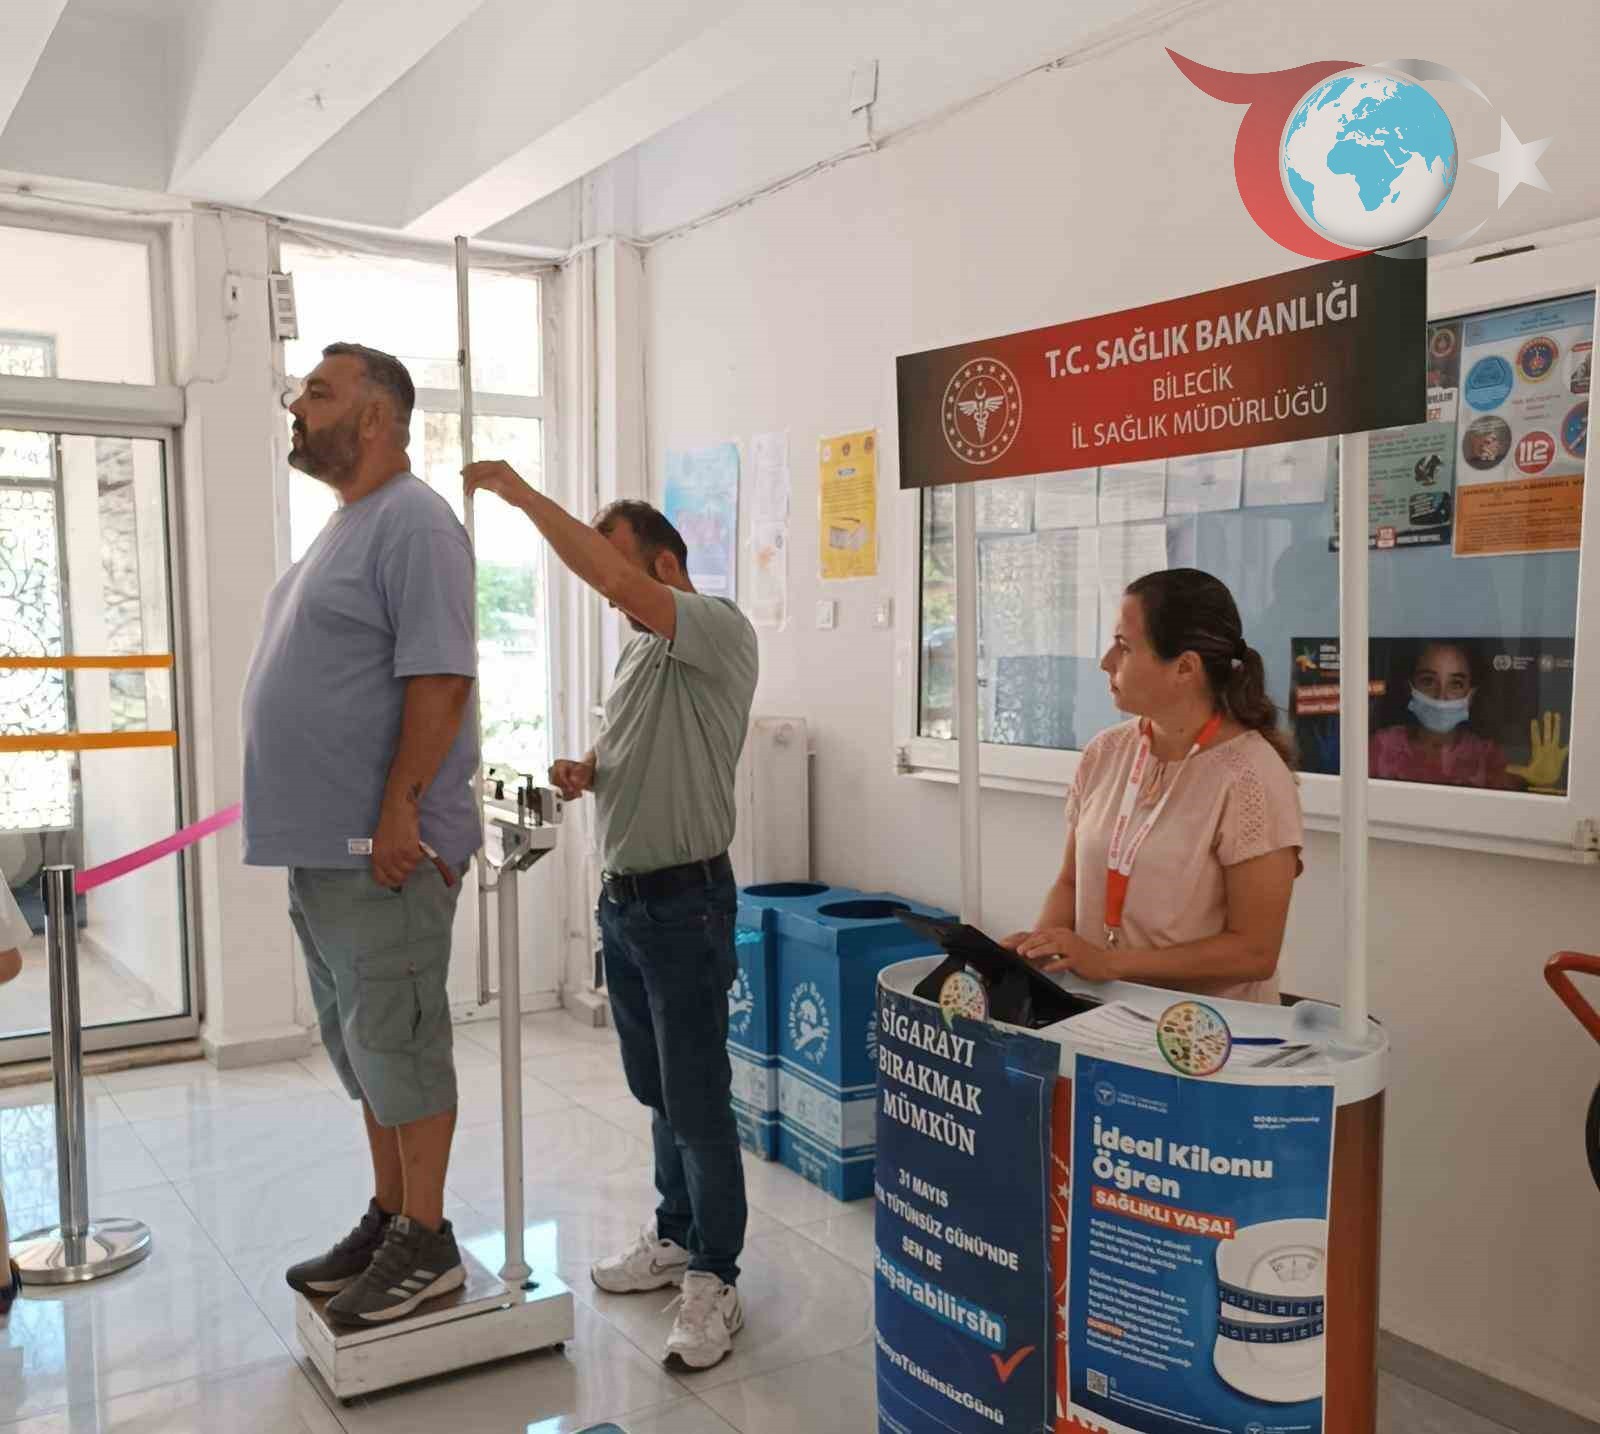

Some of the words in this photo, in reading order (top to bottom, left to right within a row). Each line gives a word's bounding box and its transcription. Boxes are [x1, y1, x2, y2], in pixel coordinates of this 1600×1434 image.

[1046, 345, 1090, 378] T.C.
[1096, 324, 1189, 371] SAĞLIK
[1195, 280, 1358, 352] BAKANLIĞI
[1152, 365, 1233, 402] BİLECİK
[1072, 422, 1089, 449] İL
[1094, 414, 1167, 447] SAĞLIK
[1173, 382, 1328, 435] MÜDÜRLÜĞÜ
[1519, 440, 1549, 462] 112
[882, 1003, 976, 1068] SİGARAYI
[879, 1044, 983, 1115] BIRAKMAK
[883, 1089, 976, 1156] MÜMKÜN
[1092, 1149, 1181, 1199] Öğren
[1168, 1142, 1273, 1179] Kilonu
[899, 1168, 910, 1187] 31
[912, 1176, 949, 1208] MAYIS
[1095, 1188, 1170, 1224] SAĞLIKLI
[1172, 1208, 1231, 1235] YAŞA!
[902, 1235, 923, 1264] SEN
[926, 1249, 943, 1272] DE
[945, 1225, 1019, 1272] GÜNÜ'NDE
